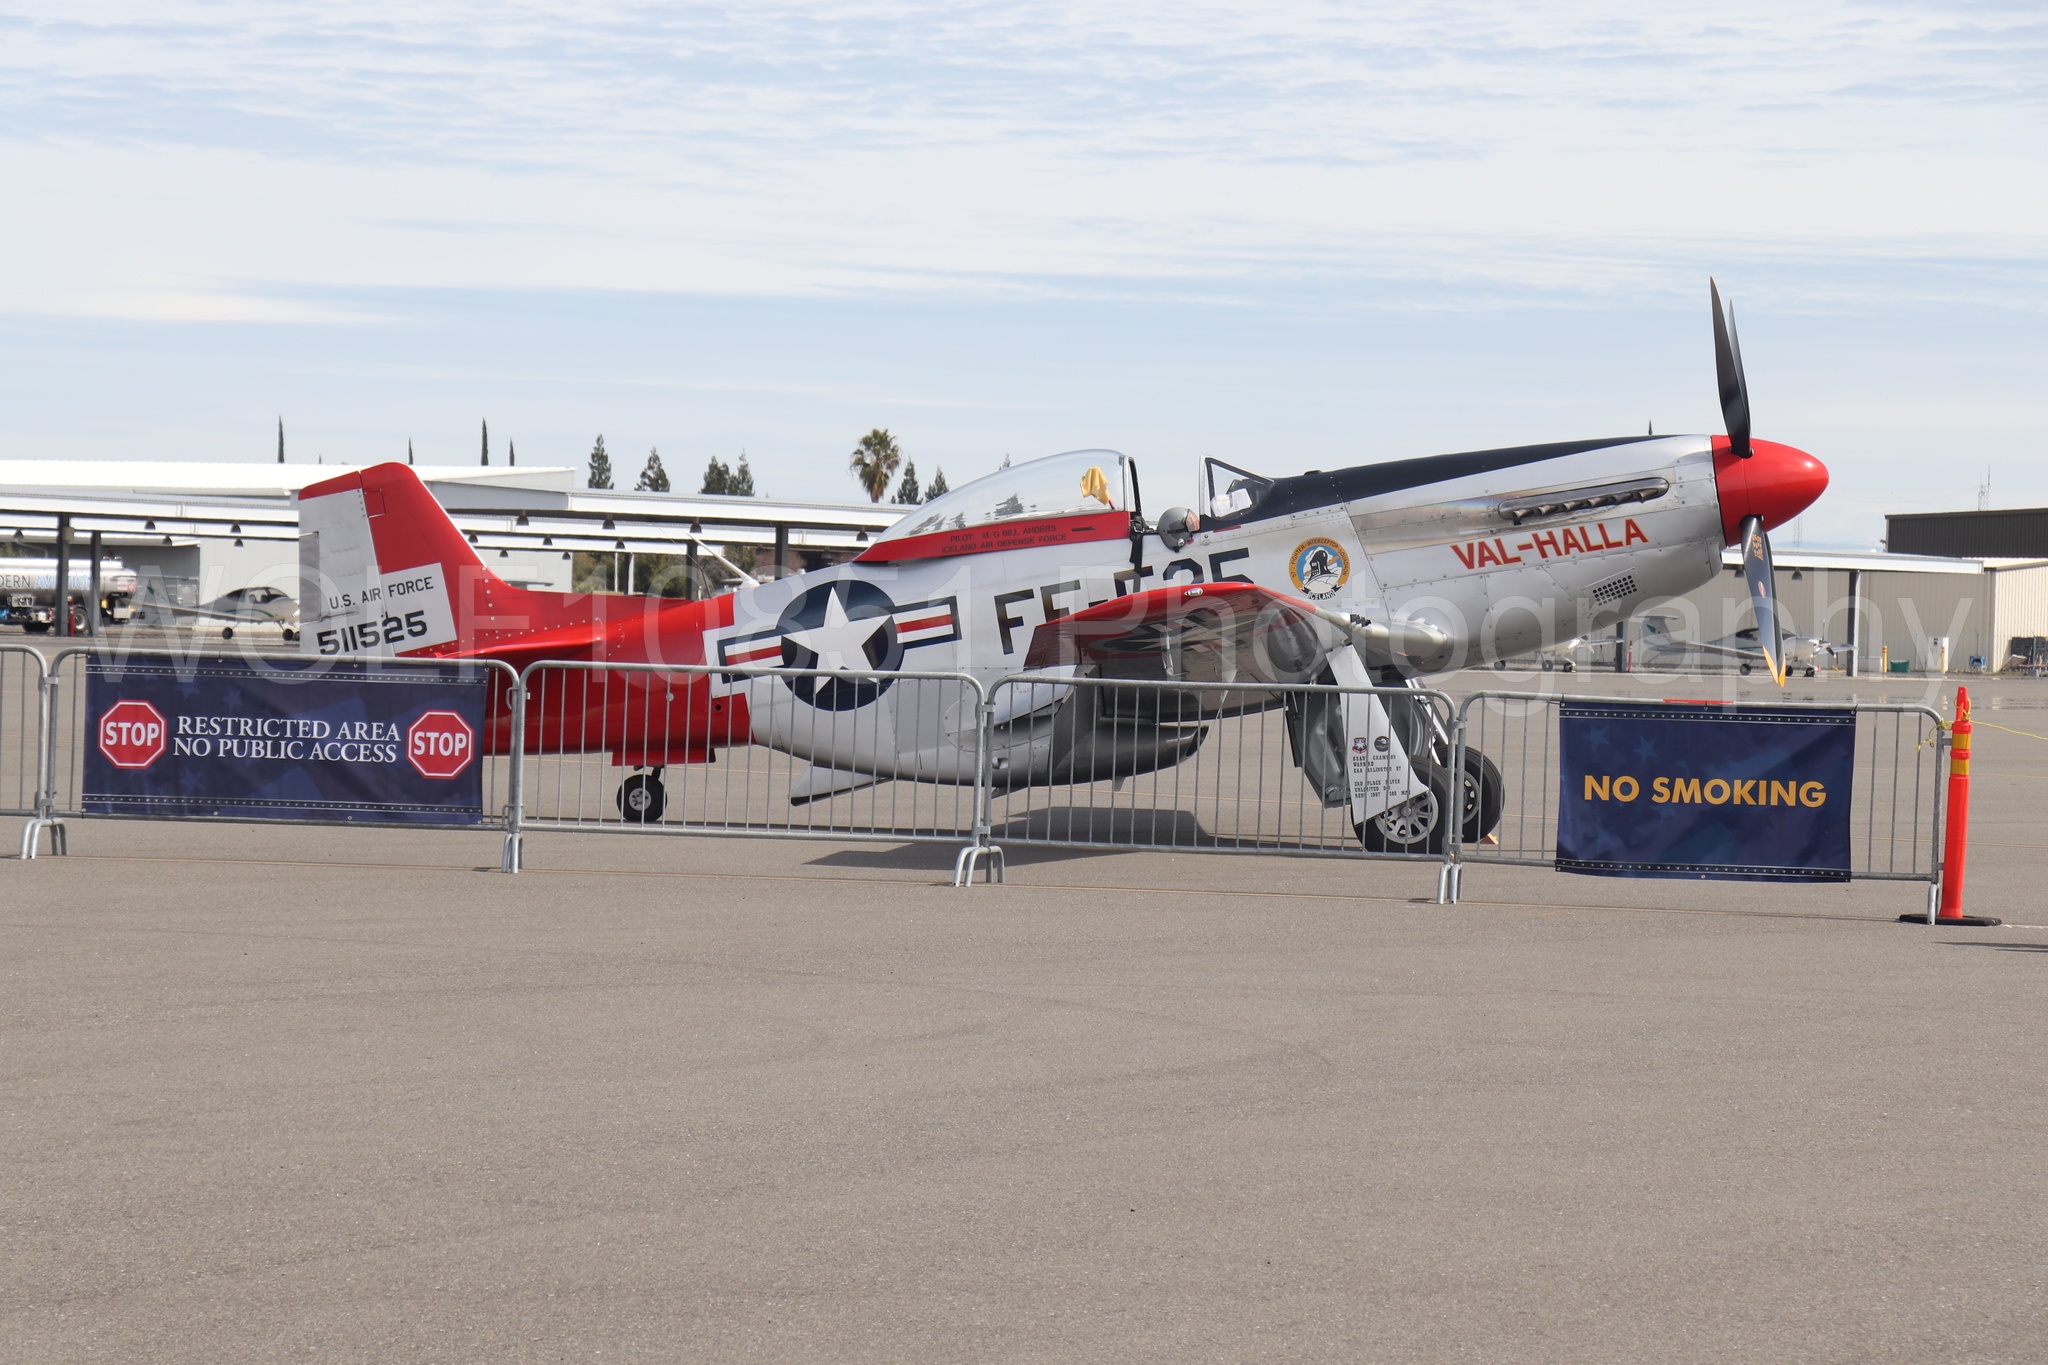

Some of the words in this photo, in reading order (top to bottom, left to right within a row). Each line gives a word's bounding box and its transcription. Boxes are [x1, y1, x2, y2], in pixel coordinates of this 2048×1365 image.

[941, 543, 976, 553] ICELAND
[997, 537, 1035, 547] DEFENSE
[1038, 533, 1067, 543] FORCE
[950, 533, 975, 543] PILOT:
[982, 531, 1000, 539] M/G
[1002, 529, 1020, 537] BILL
[1023, 524, 1057, 534] ANDERS
[1450, 518, 1649, 570] VAL-HALLA
[328, 594, 356, 610] U.S.
[361, 587, 382, 604] AIR
[387, 576, 434, 598] FORCE
[316, 610, 428, 656] 511525
[105, 721, 160, 747] STOP
[176, 716, 331, 739] RESTRICTED
[335, 721, 402, 742] AREA
[172, 737, 211, 757] NO
[217, 738, 304, 760] PUBLIC
[308, 742, 398, 764] ACCESS
[413, 731, 467, 757] STOP
[1584, 774, 1640, 803] NO
[1651, 776, 1827, 808] SMOKING
